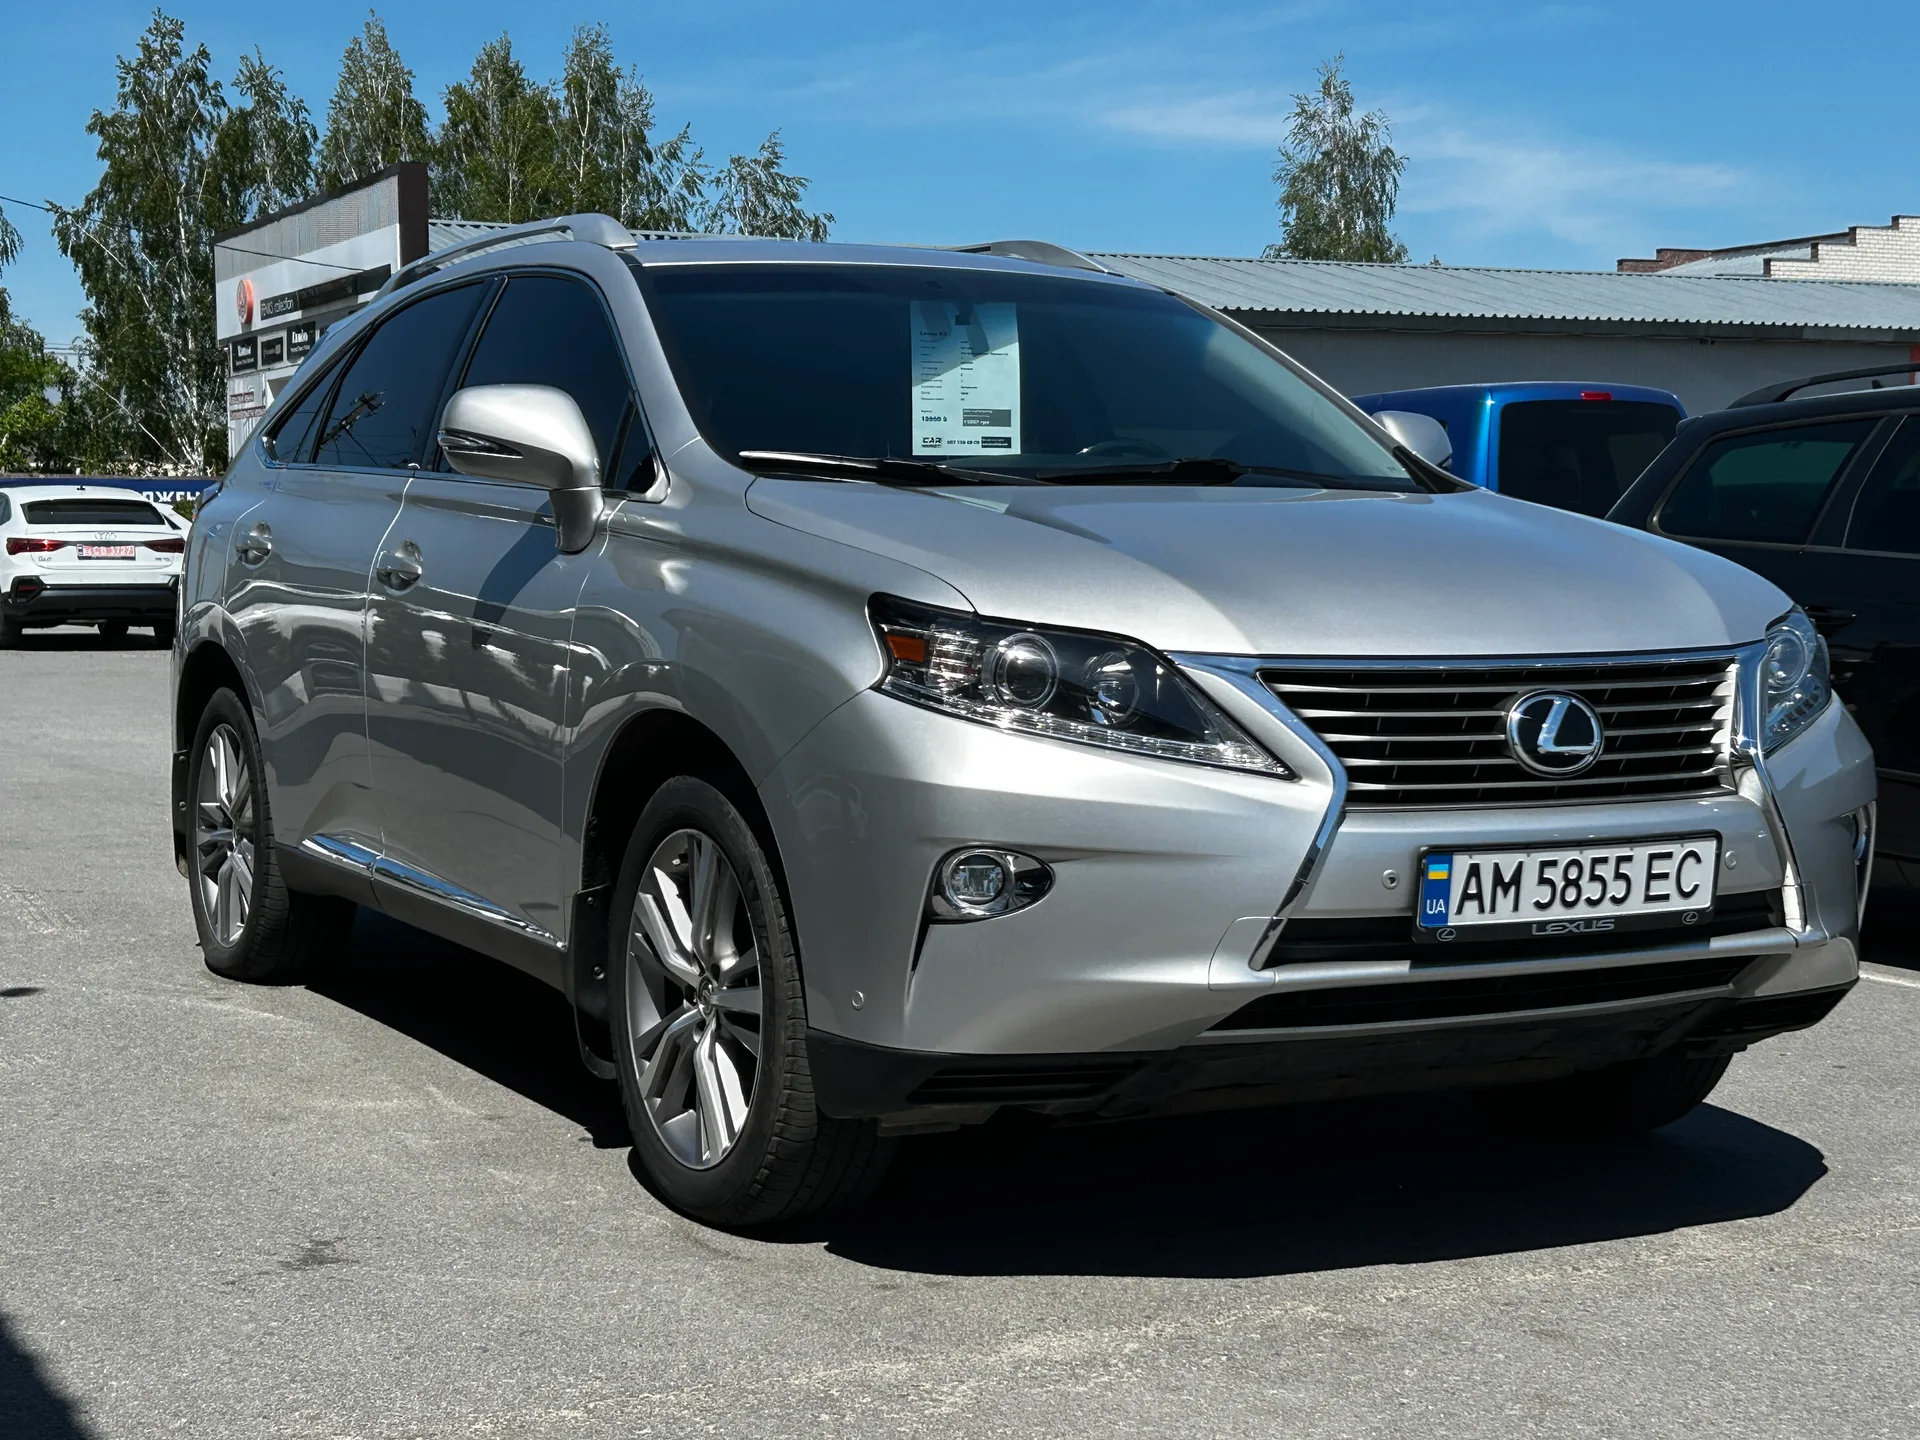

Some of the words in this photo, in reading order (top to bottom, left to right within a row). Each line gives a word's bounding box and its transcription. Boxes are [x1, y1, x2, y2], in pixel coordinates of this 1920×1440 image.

[1454, 860, 1524, 915] AM
[1532, 854, 1634, 910] 5855
[1643, 849, 1703, 904] EC
[1426, 898, 1446, 914] UA
[1531, 918, 1615, 936] LEXUS
